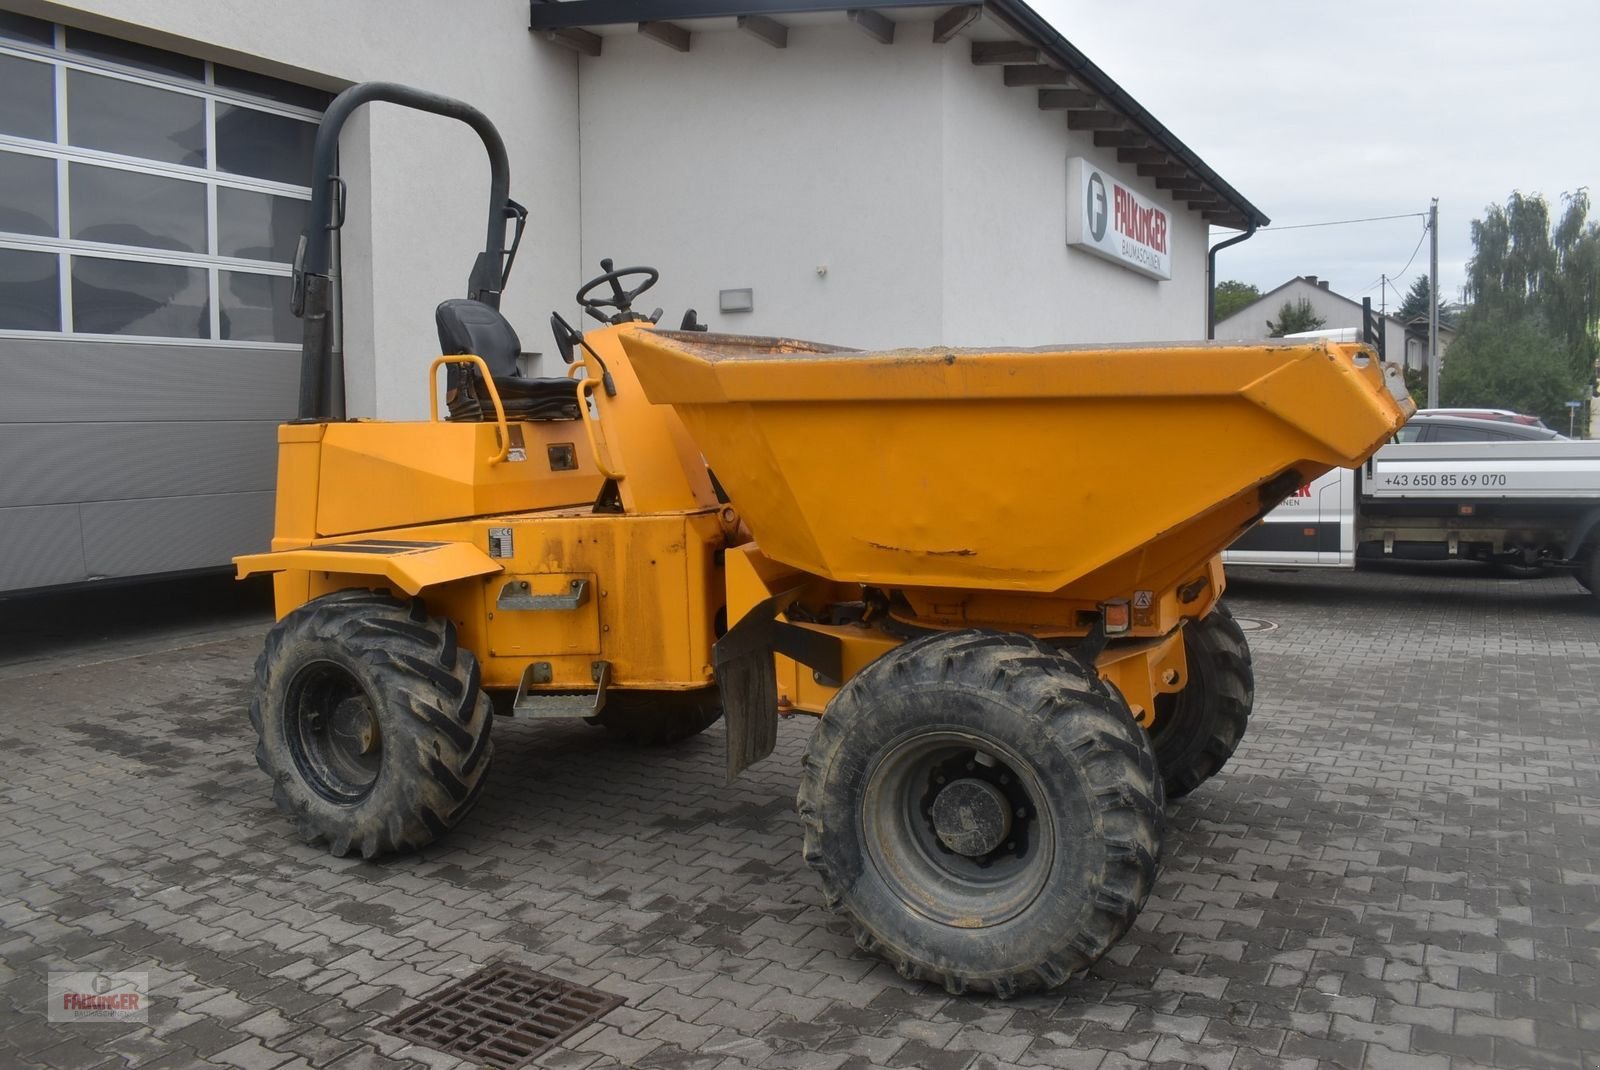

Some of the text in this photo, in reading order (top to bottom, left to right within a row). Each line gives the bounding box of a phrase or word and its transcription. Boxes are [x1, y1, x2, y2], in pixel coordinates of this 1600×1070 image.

[1114, 184, 1167, 255] FALKINGER
[1122, 239, 1160, 270] BAUMASCHINEN
[1385, 474, 1506, 486] +43 650 85 69 070
